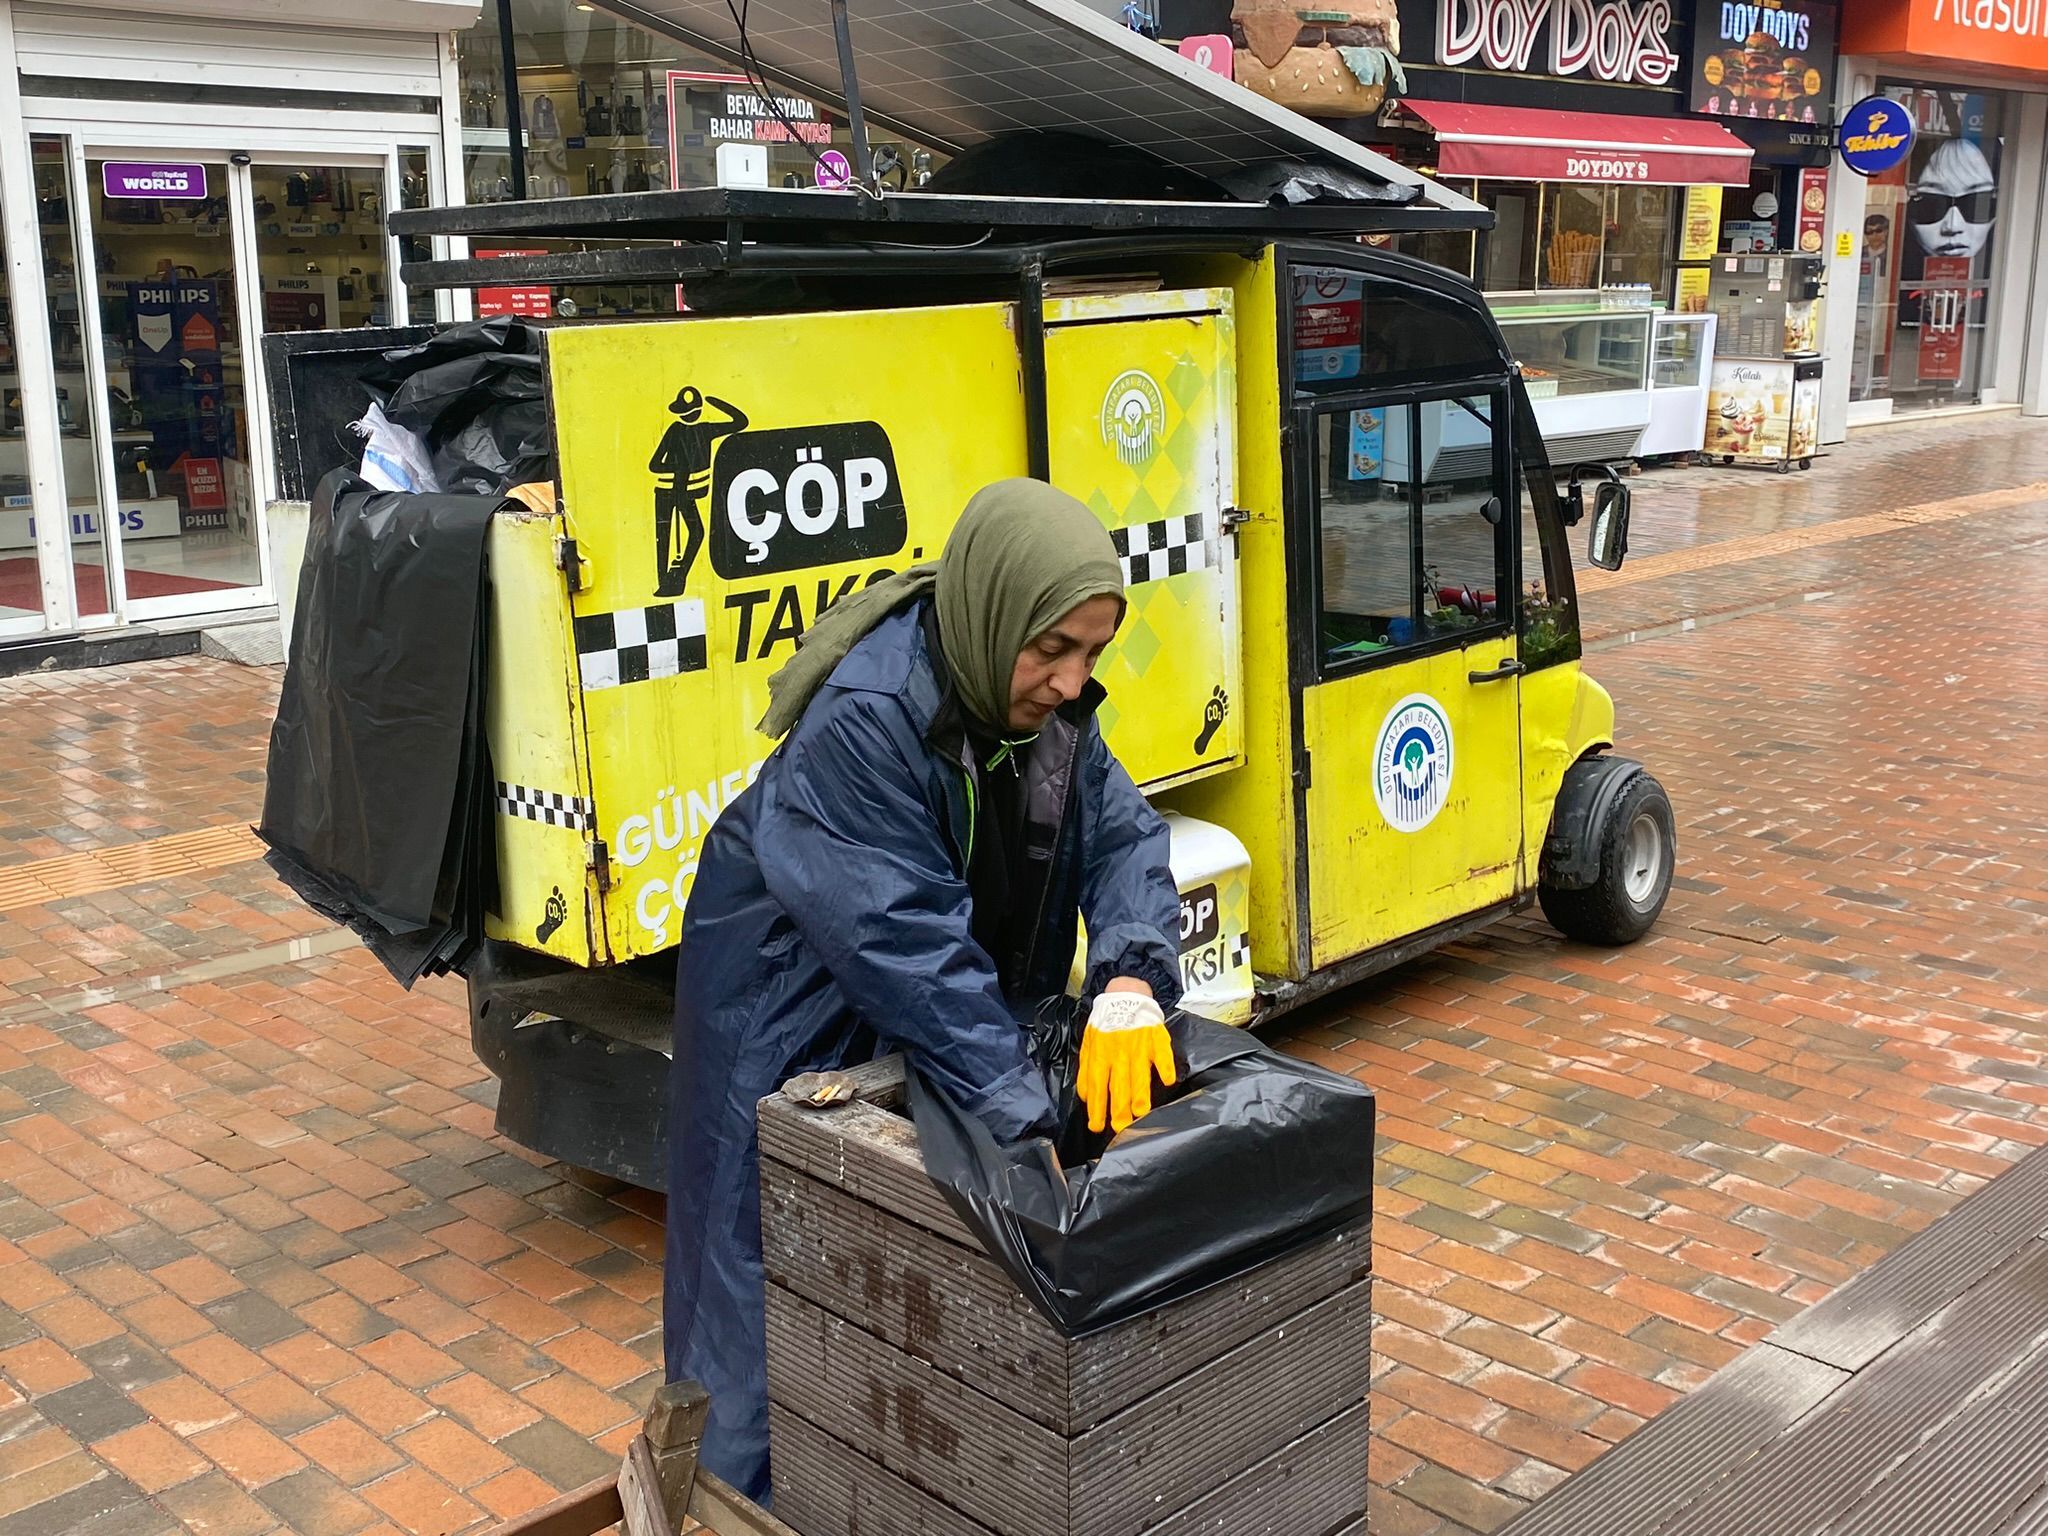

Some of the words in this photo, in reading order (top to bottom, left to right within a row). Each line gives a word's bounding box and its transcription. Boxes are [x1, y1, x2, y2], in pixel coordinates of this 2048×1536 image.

[1720, 2, 1760, 43] DOY
[1761, 7, 1811, 51] DOYS
[1436, 0, 1552, 71] DOY
[1550, 0, 1680, 85] DOYS
[726, 94, 766, 116] BEYAZ
[709, 118, 753, 140] BAHAR
[1844, 133, 1908, 153] Tchibo
[1566, 158, 1649, 179] DOYDOY'S
[122, 178, 189, 191] WORLD
[278, 280, 310, 290] PHILIPS
[724, 446, 890, 564] ÇÖP
[1382, 711, 1414, 794] ODUNPAZARI
[615, 760, 765, 868] GÜNE
